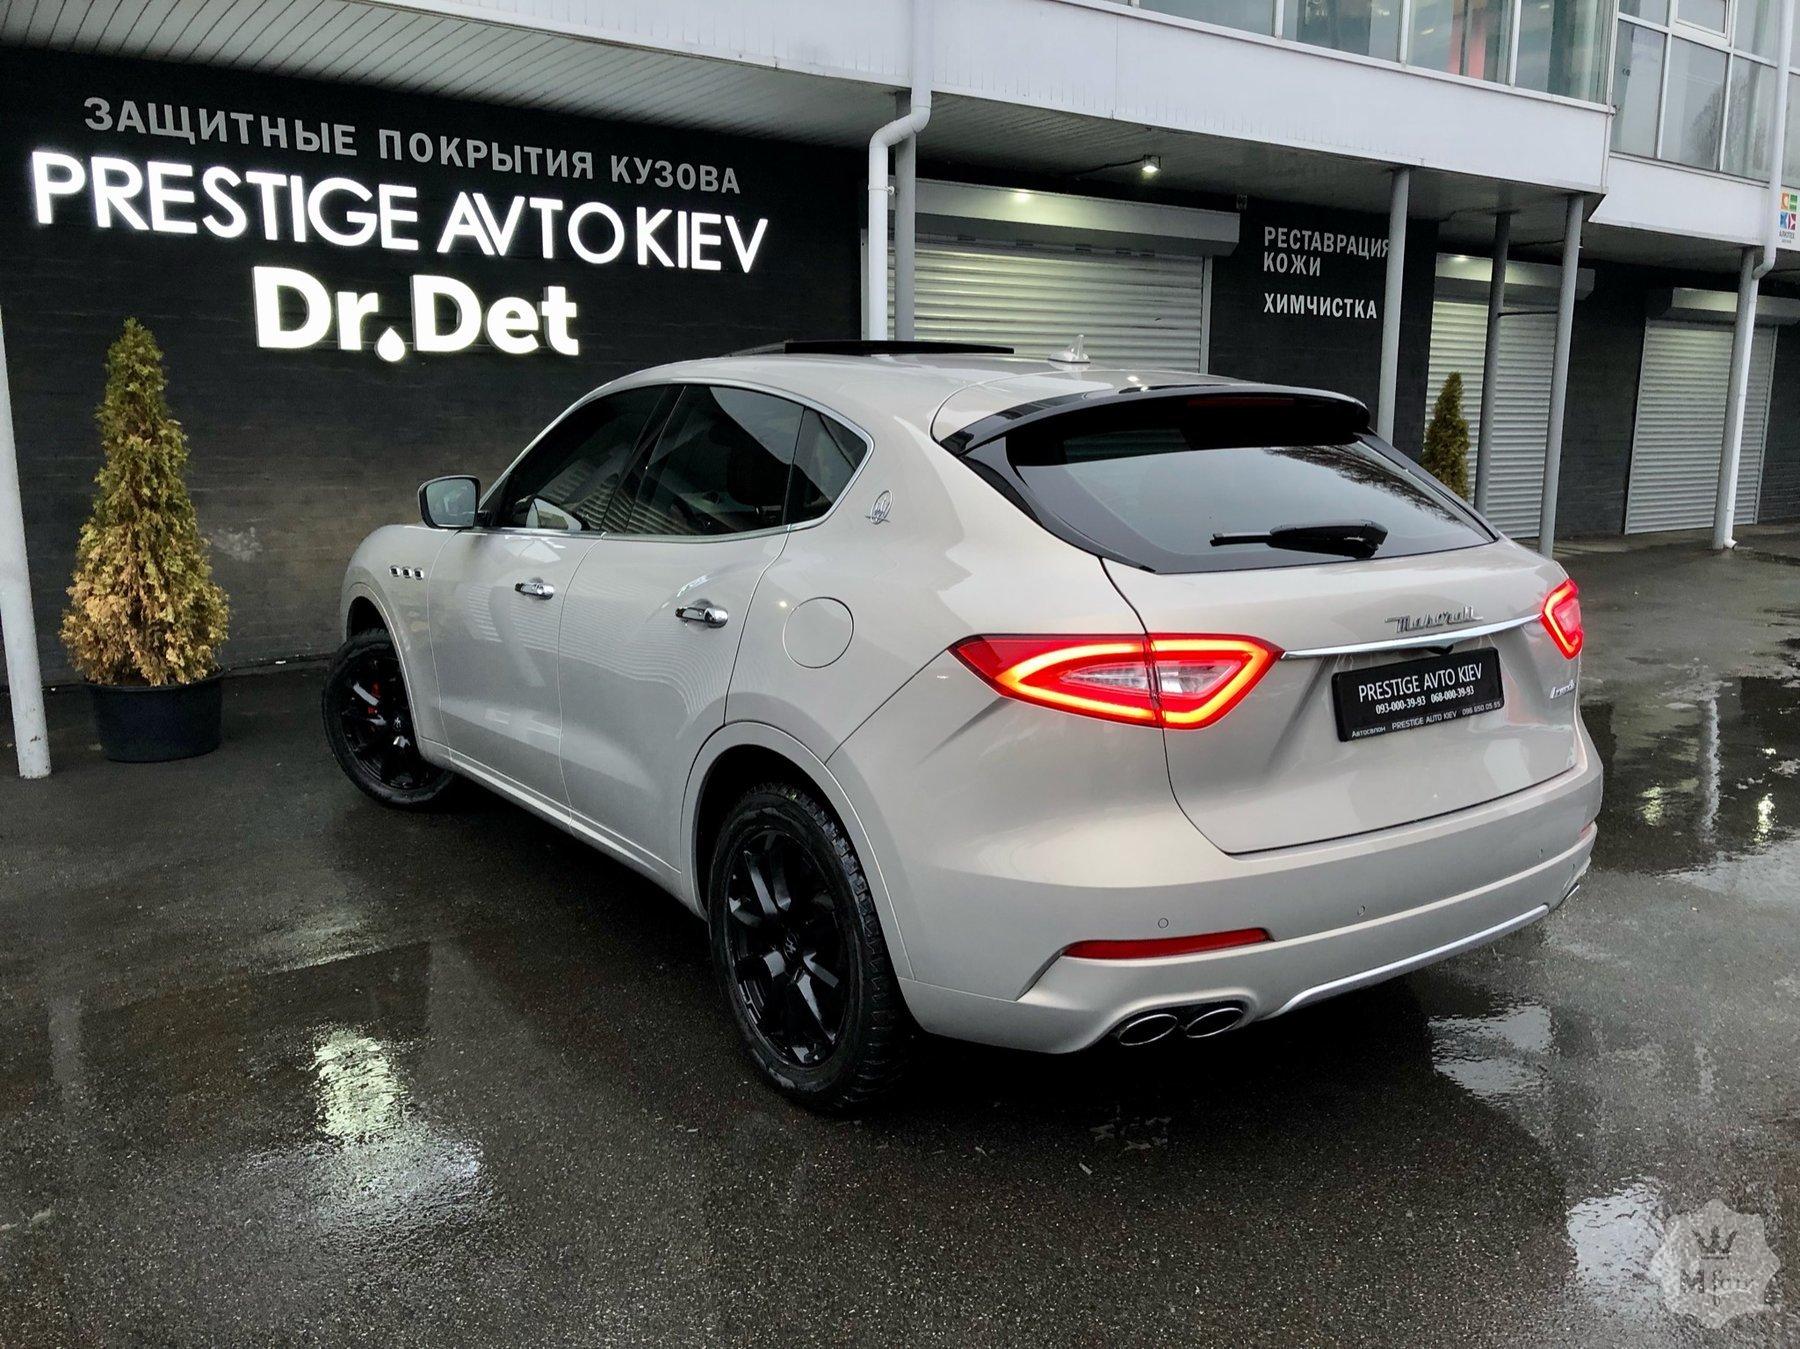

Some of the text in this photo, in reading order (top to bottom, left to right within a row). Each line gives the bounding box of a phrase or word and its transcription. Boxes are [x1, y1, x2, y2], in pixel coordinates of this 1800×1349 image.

[84, 97, 741, 195] ЗАЩИТНЫЕ ПОКРЫТИЯ КУЗОВА
[30, 151, 419, 252] PRESTIGE
[1264, 227, 1390, 259] РЕСТАВРАЦИЯ
[1263, 251, 1321, 277] КОЖИ
[1263, 293, 1378, 320] ХИМЧИСТКА
[1358, 663, 1482, 702] PRESTIGE AVTO KIEV
[1351, 726, 1386, 738] Автосалон
[1391, 717, 1424, 731] PRESTIGE
